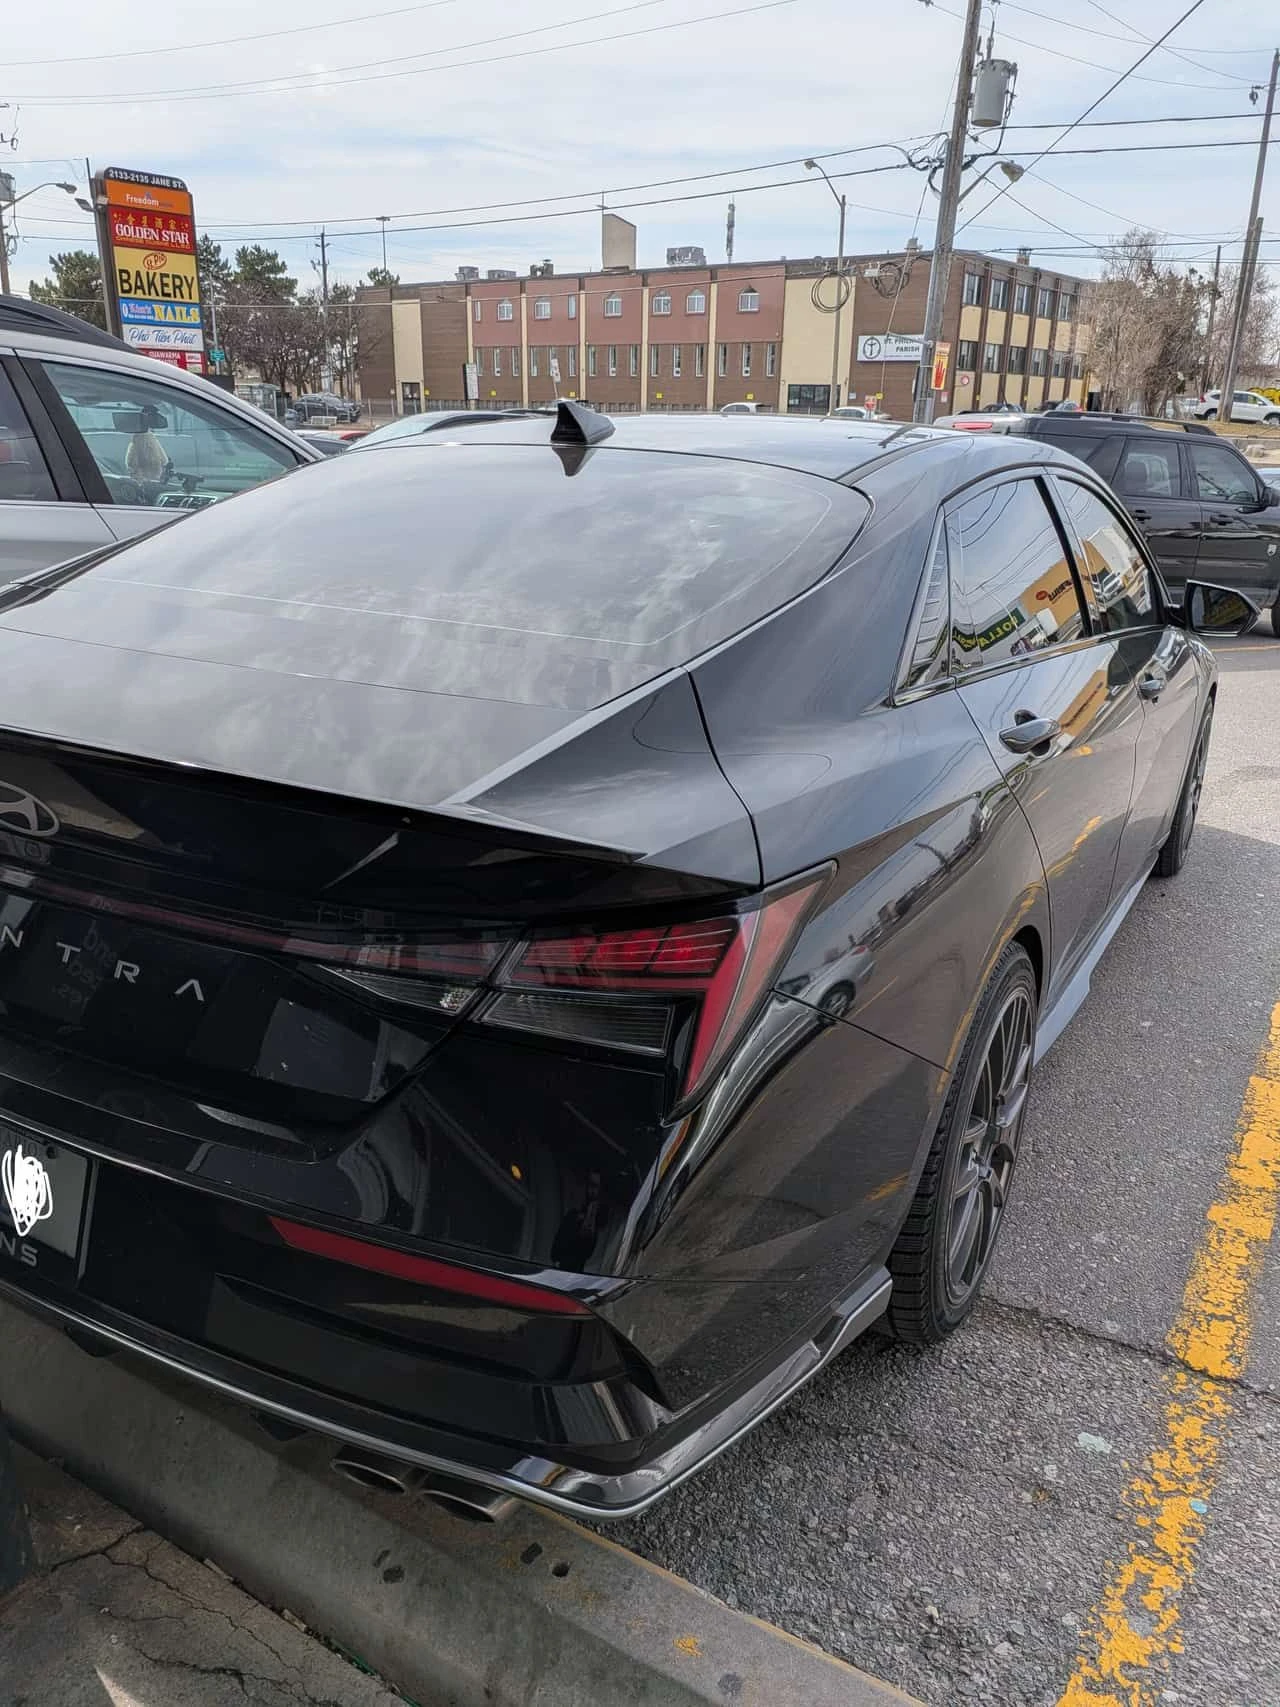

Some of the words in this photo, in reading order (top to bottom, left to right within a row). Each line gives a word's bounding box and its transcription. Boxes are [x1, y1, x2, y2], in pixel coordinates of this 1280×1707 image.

[109, 170, 149, 185] 2133-2135
[150, 176, 171, 187] JANE
[172, 181, 184, 189] ST.
[125, 193, 160, 207] Freedom
[115, 223, 159, 241] GOLDEN
[161, 230, 190, 245] STAR
[118, 267, 195, 301] BAKERY
[152, 304, 201, 324] NAILS
